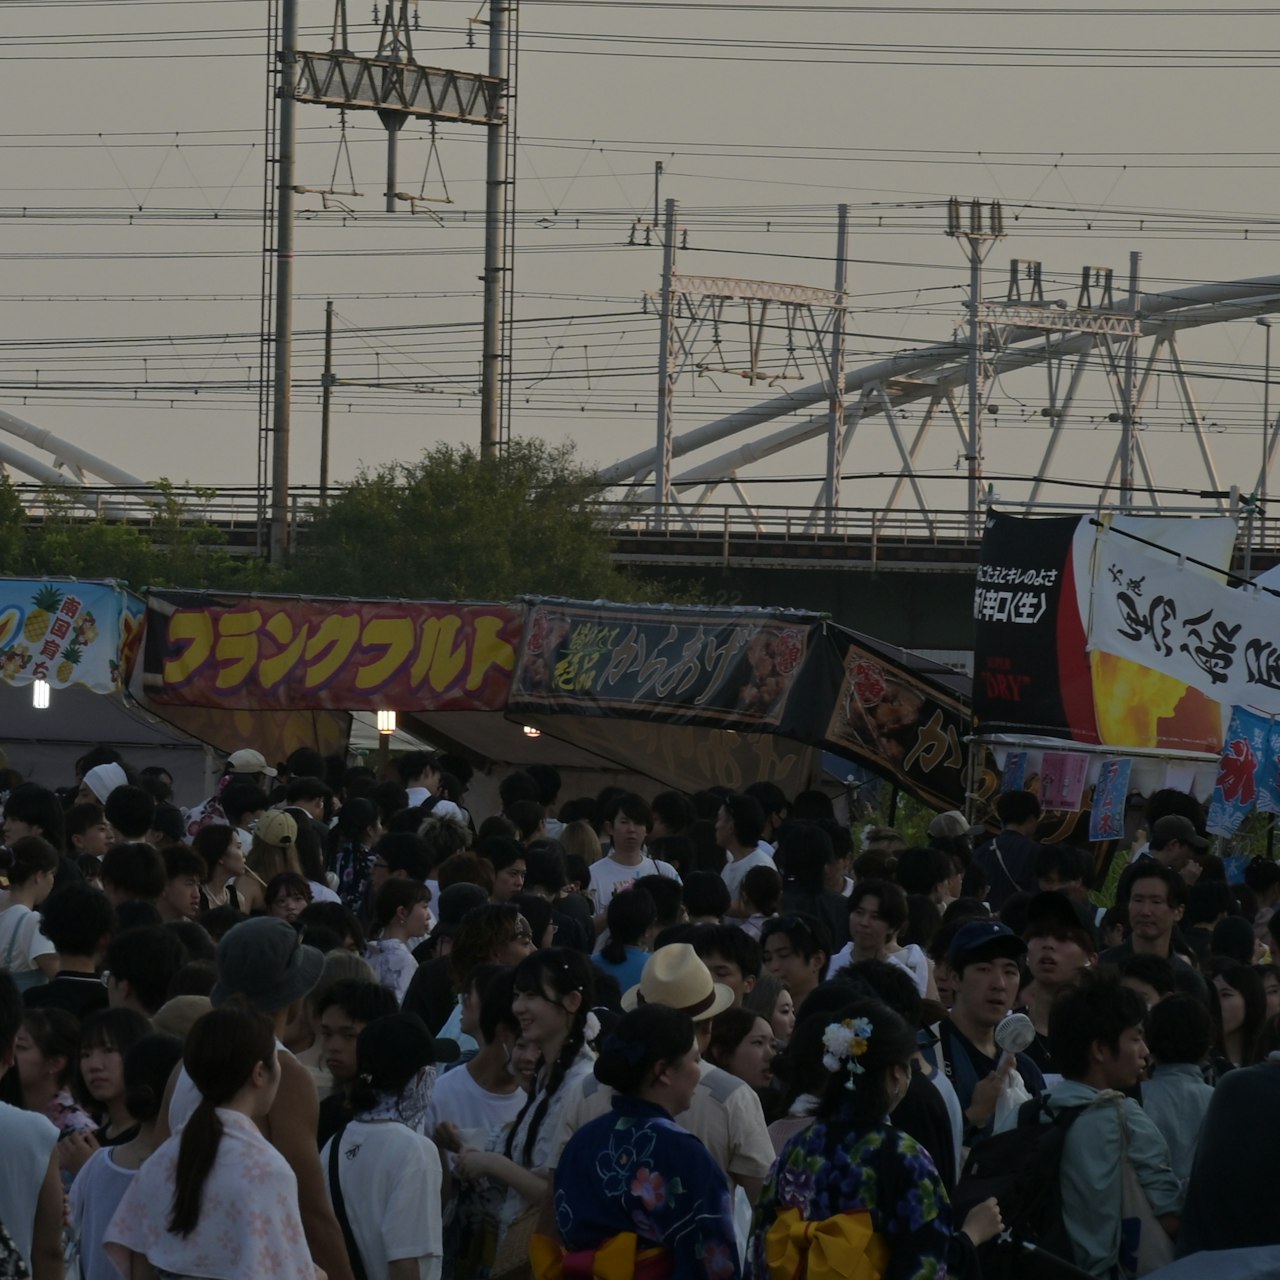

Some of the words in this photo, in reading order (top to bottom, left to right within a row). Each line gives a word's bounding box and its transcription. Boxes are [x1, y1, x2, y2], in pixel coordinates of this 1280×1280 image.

[31, 595, 83, 680] 南国育ち
[162, 606, 516, 692] フランクフルト
[596, 621, 756, 705] からあげ
